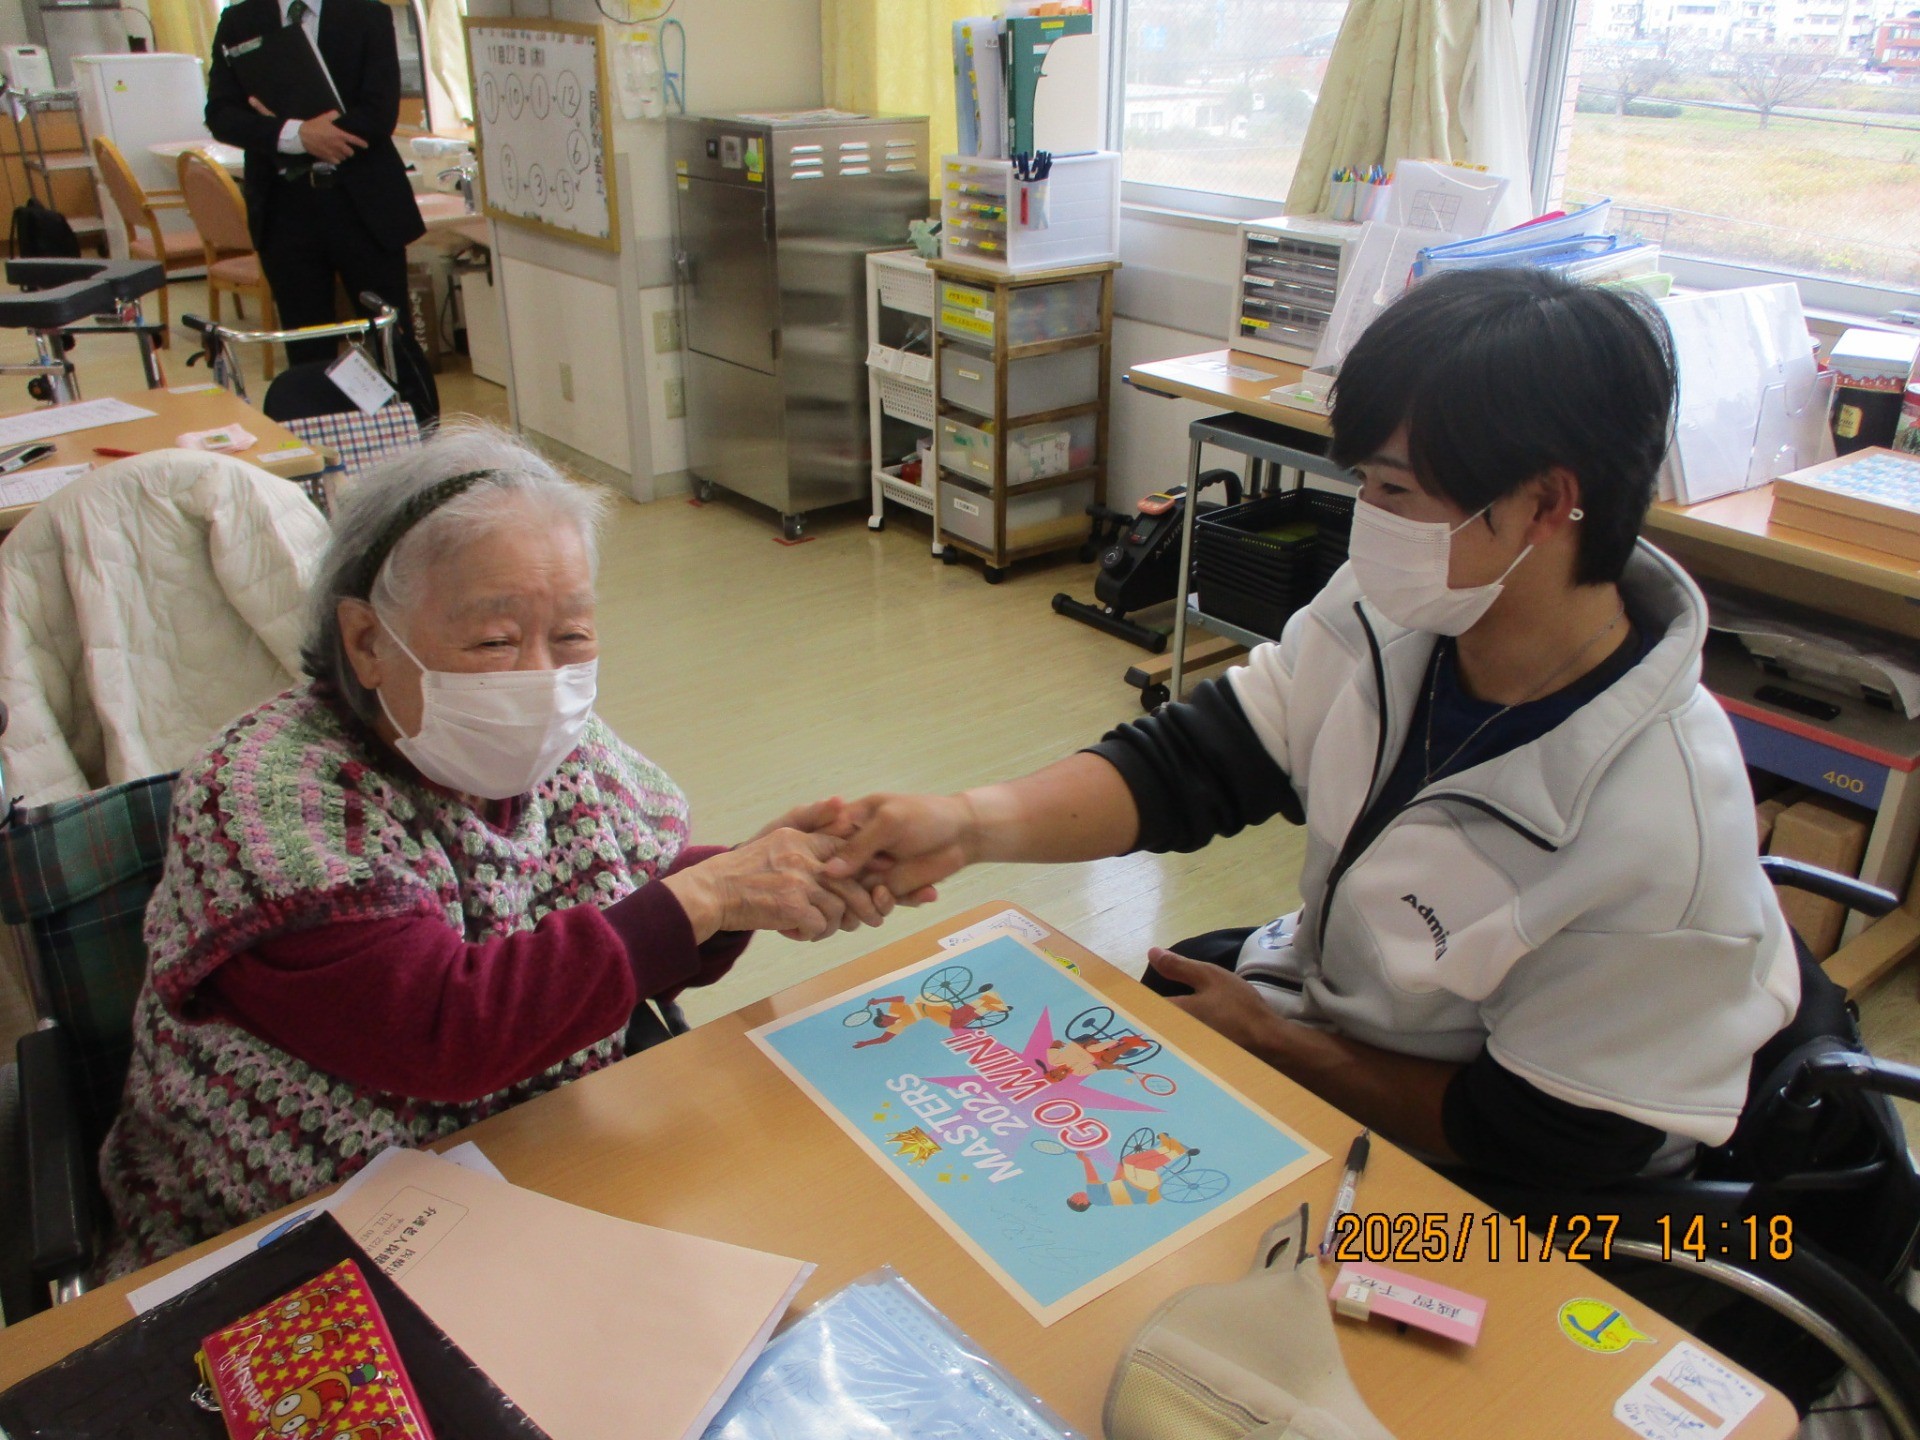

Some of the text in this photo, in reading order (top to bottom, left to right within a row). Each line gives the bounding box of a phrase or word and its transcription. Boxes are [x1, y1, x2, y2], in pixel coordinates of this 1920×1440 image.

[1823, 770, 1865, 794] 400
[885, 1072, 1025, 1184] MASTERS
[946, 1080, 1031, 1137] 2025
[1031, 1097, 1112, 1151] GO
